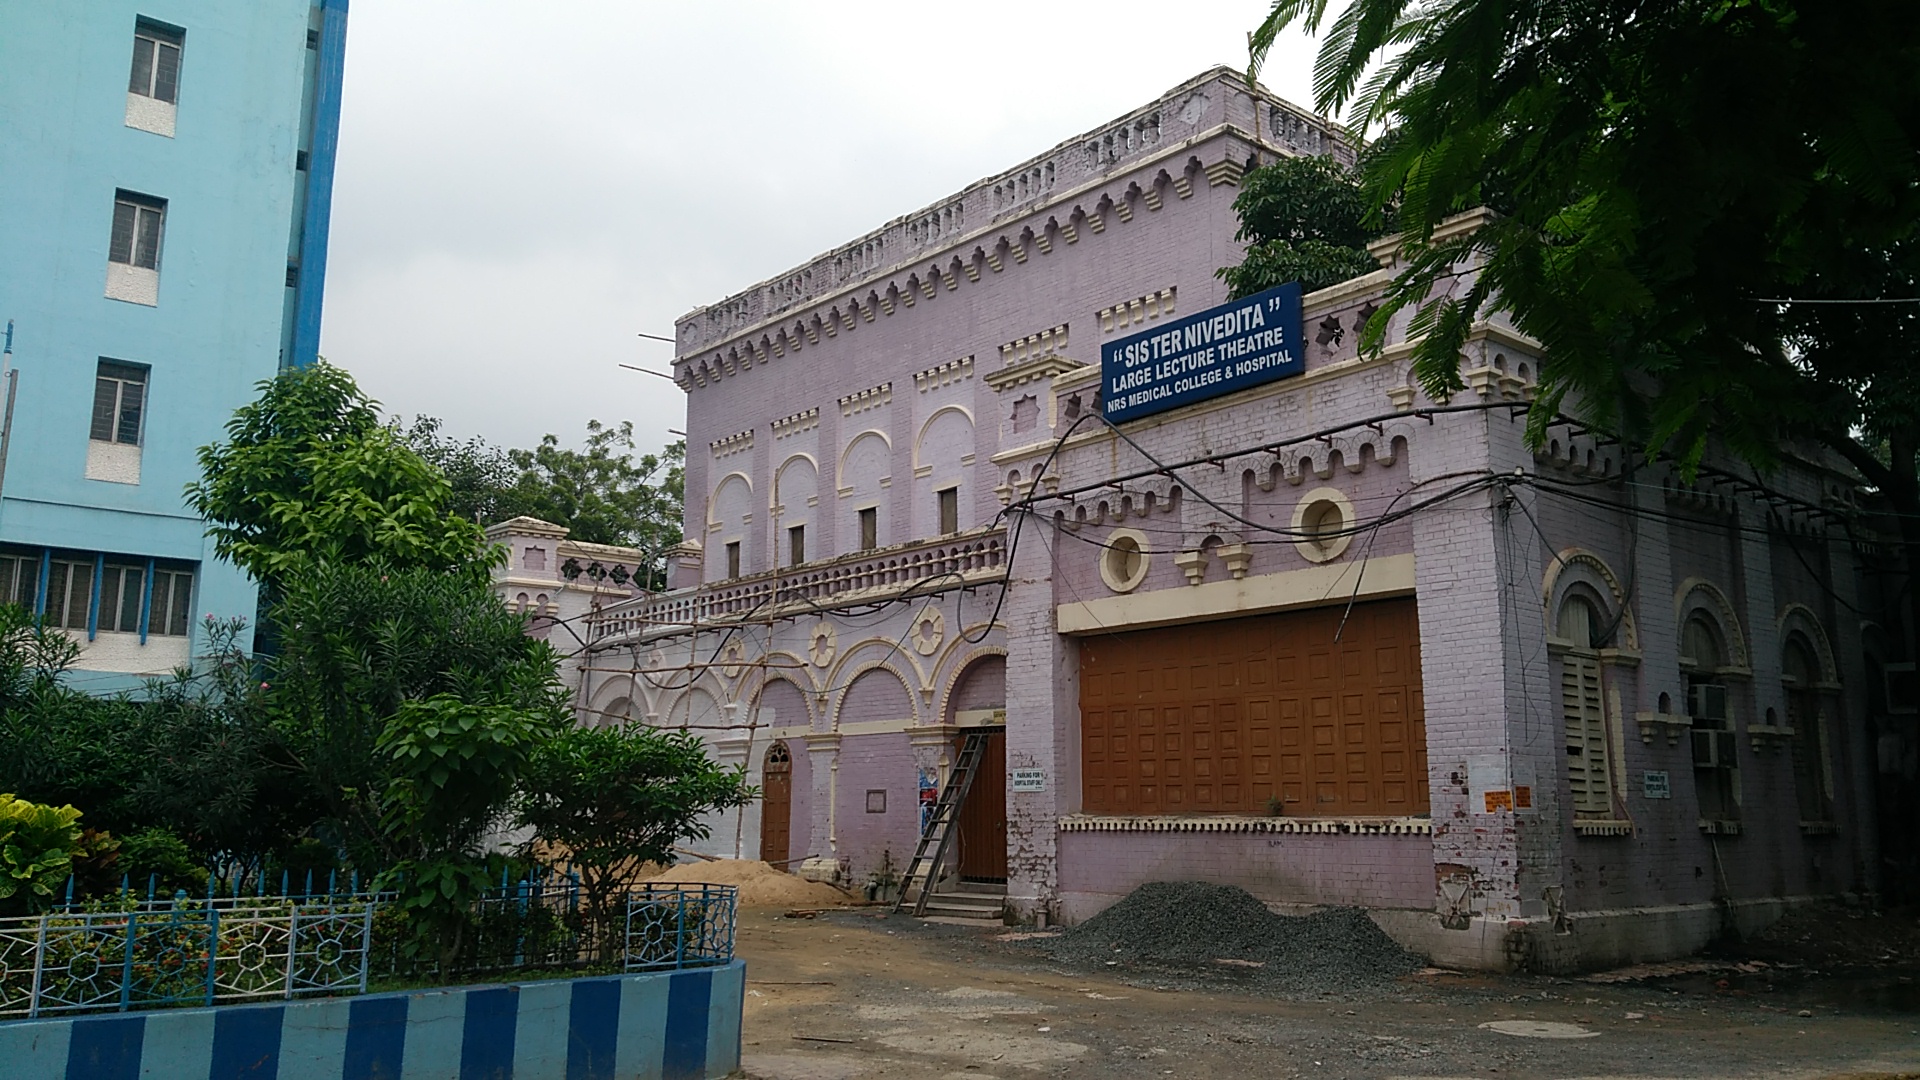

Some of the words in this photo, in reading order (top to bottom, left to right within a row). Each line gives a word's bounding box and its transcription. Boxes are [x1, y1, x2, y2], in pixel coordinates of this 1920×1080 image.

[1107, 395, 1127, 413] NRS
[1128, 383, 1173, 407] MEDICAL
[1174, 368, 1222, 393] COLLEGE
[1225, 366, 1234, 379] &
[1236, 349, 1293, 376] HOSPITAL
[1112, 366, 1152, 394] LARGE
[1155, 347, 1215, 381] LECTURE
[1218, 326, 1284, 361] THEATRE
